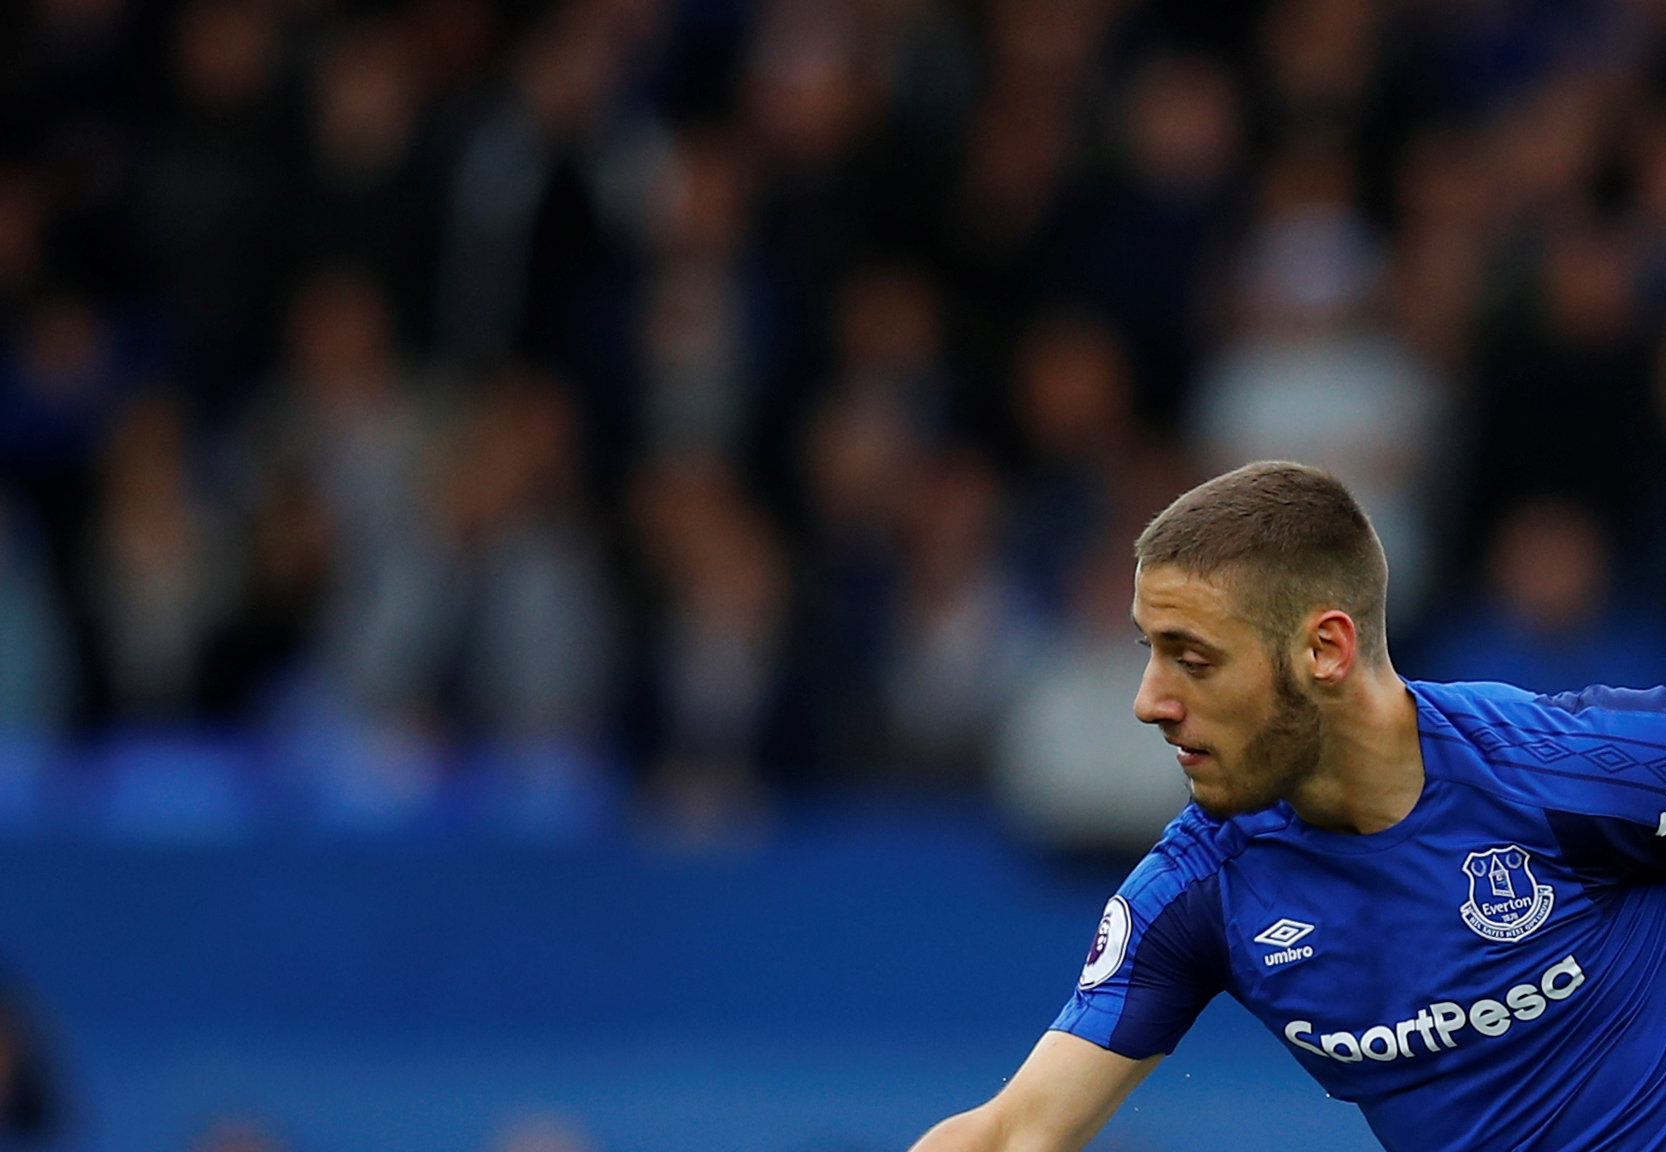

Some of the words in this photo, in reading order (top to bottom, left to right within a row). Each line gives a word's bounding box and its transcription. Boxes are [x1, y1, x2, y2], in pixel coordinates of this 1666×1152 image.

[1482, 896, 1532, 916] Everton
[1264, 945, 1314, 966] umbro
[1284, 954, 1587, 1064] SportPesa
